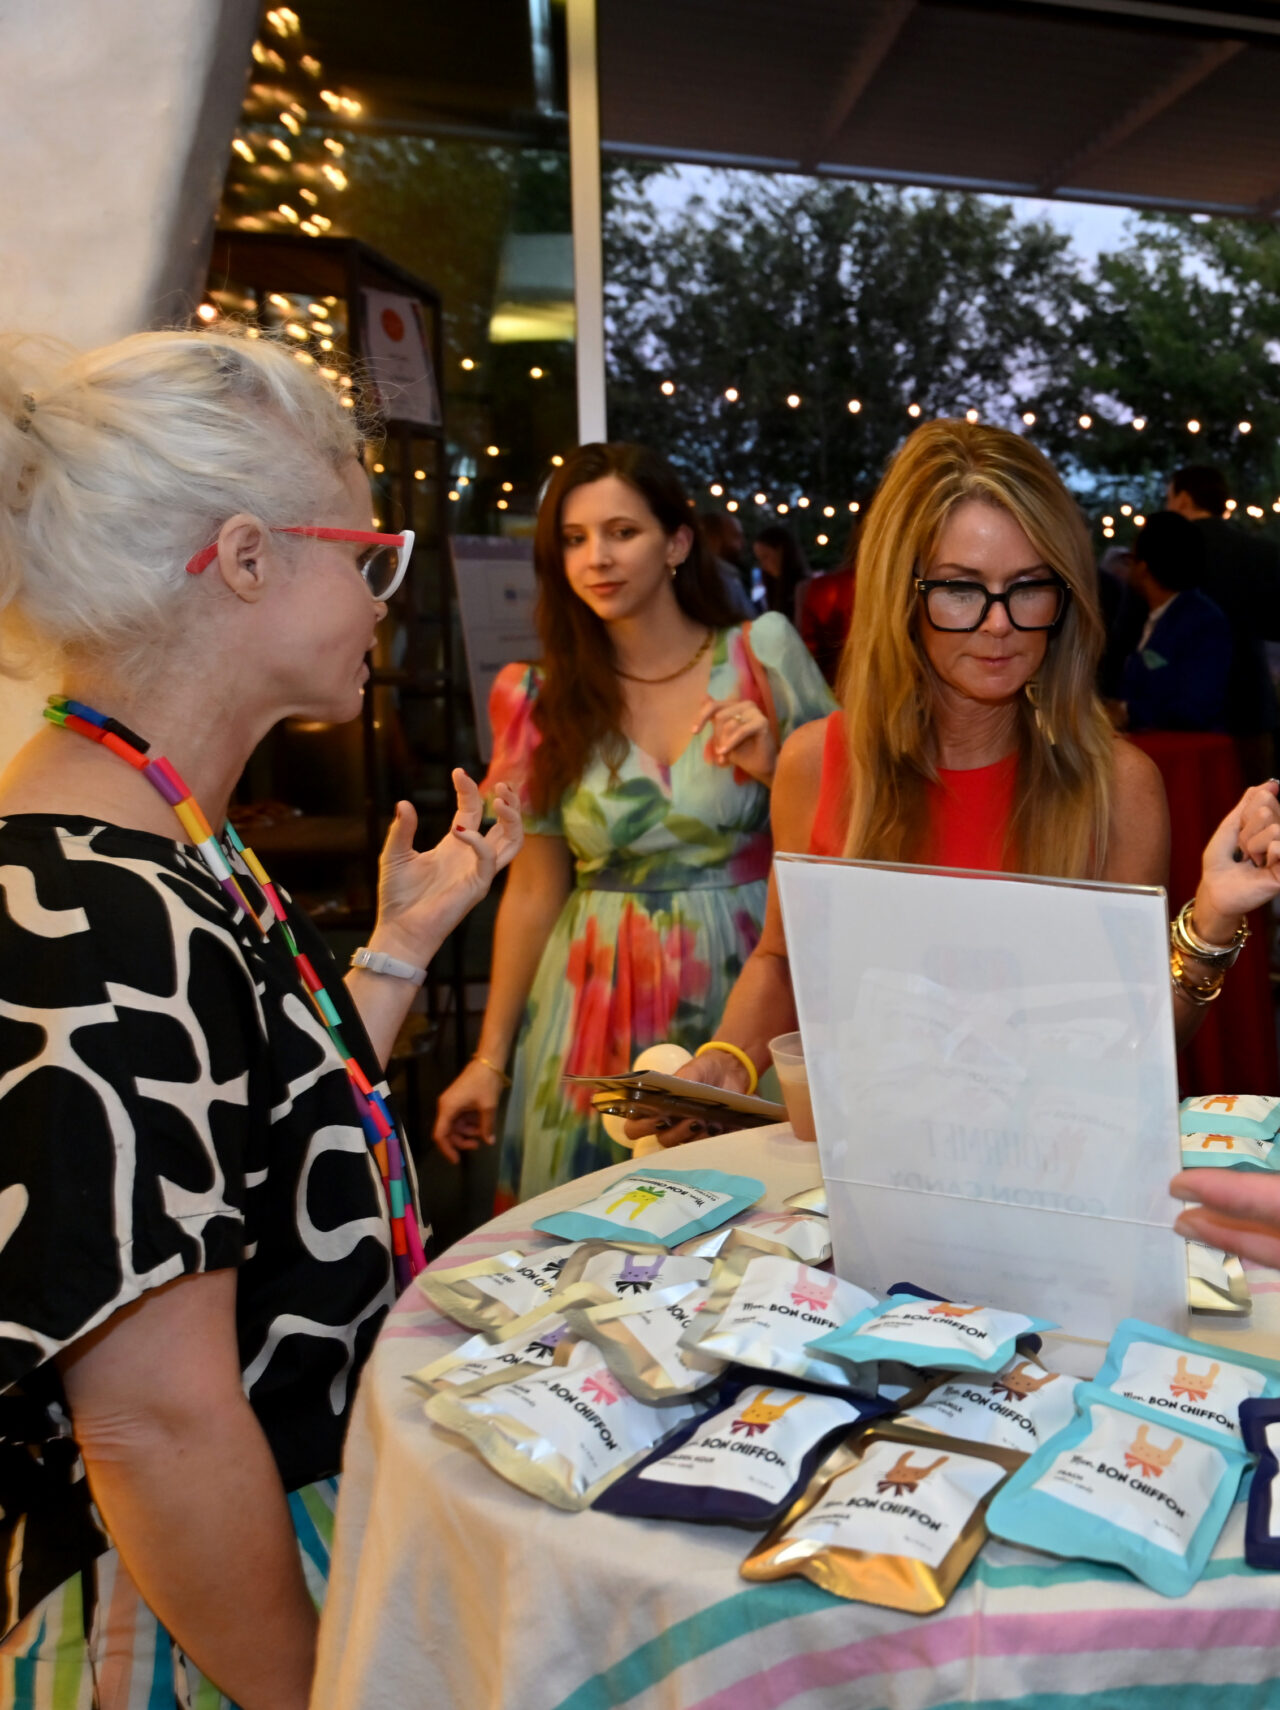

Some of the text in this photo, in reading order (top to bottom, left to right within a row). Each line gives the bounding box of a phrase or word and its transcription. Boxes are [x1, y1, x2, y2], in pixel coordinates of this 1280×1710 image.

[769, 1303, 799, 1317] BON
[801, 1312, 839, 1329] CHIFF
[902, 1313, 931, 1322] BON
[933, 1315, 988, 1340] CHIFFON
[548, 1383, 579, 1404] BON
[574, 1399, 618, 1451] CHIFFON
[961, 1389, 991, 1406] BON
[988, 1401, 1038, 1437] CHIFFON
[1148, 1395, 1178, 1409] BON
[1180, 1403, 1235, 1430] CHIFFON
[700, 1437, 731, 1449] BON
[730, 1441, 786, 1467] CHIFFON
[1097, 1462, 1129, 1483] BON
[1129, 1478, 1186, 1519] CHIFFON
[847, 1497, 880, 1508] BON
[879, 1500, 942, 1532] CHIFFON
